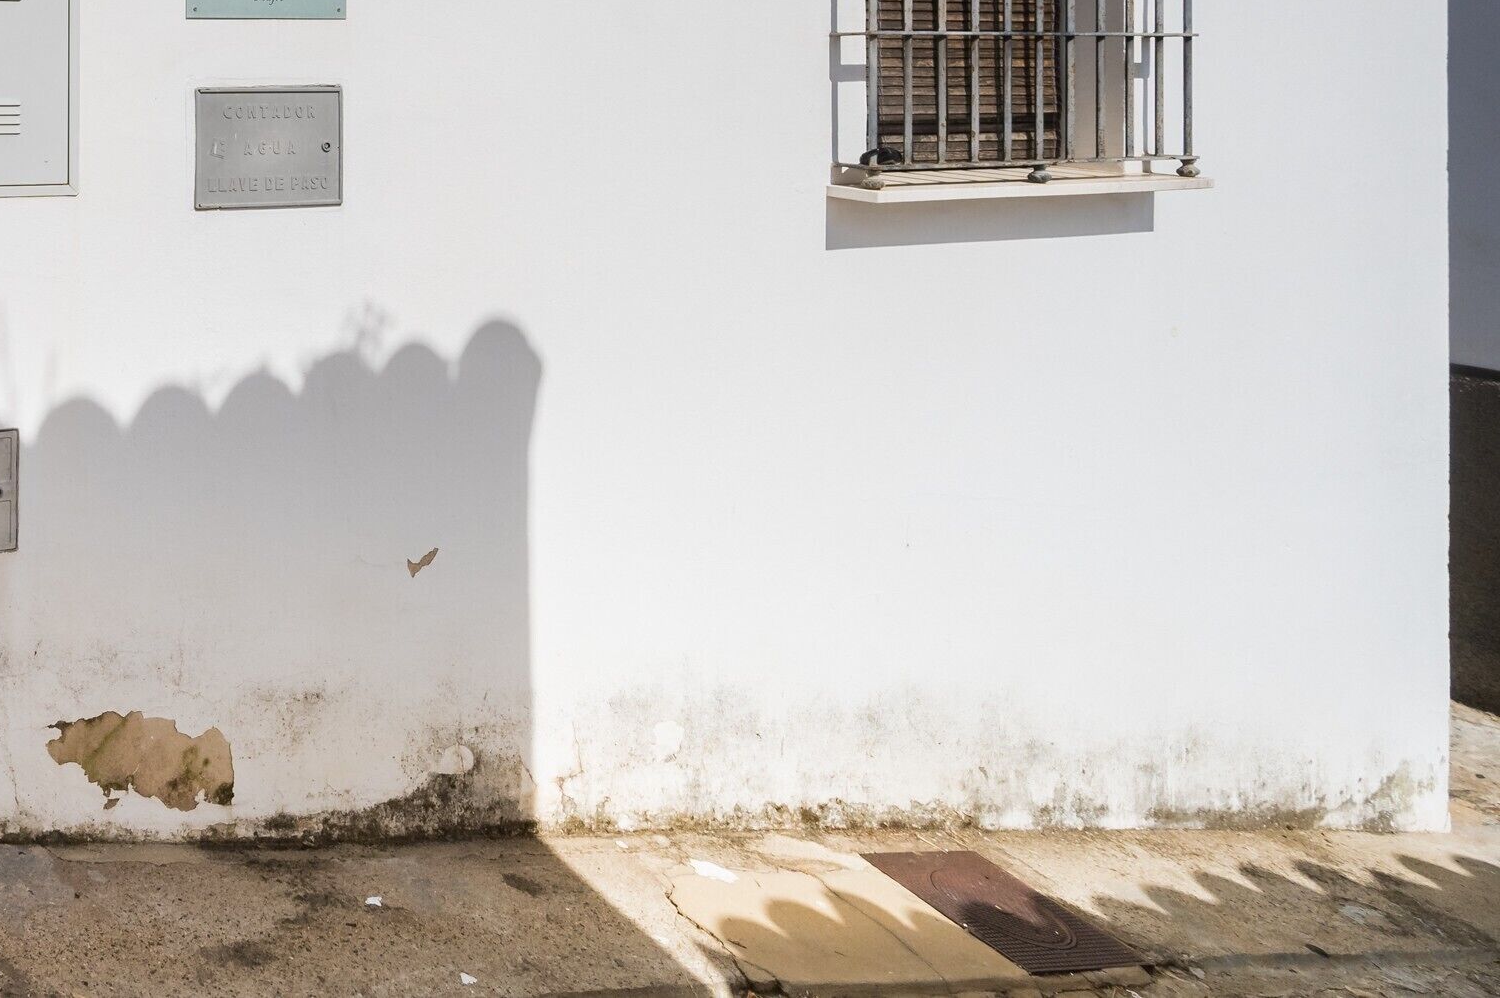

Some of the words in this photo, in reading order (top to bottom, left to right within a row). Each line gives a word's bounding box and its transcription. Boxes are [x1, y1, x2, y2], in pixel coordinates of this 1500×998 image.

[223, 105, 316, 120] CONTADOR
[243, 139, 297, 155] AGUA
[207, 178, 258, 192] LLAVE
[265, 177, 285, 190] DE
[291, 176, 331, 190] PASO
